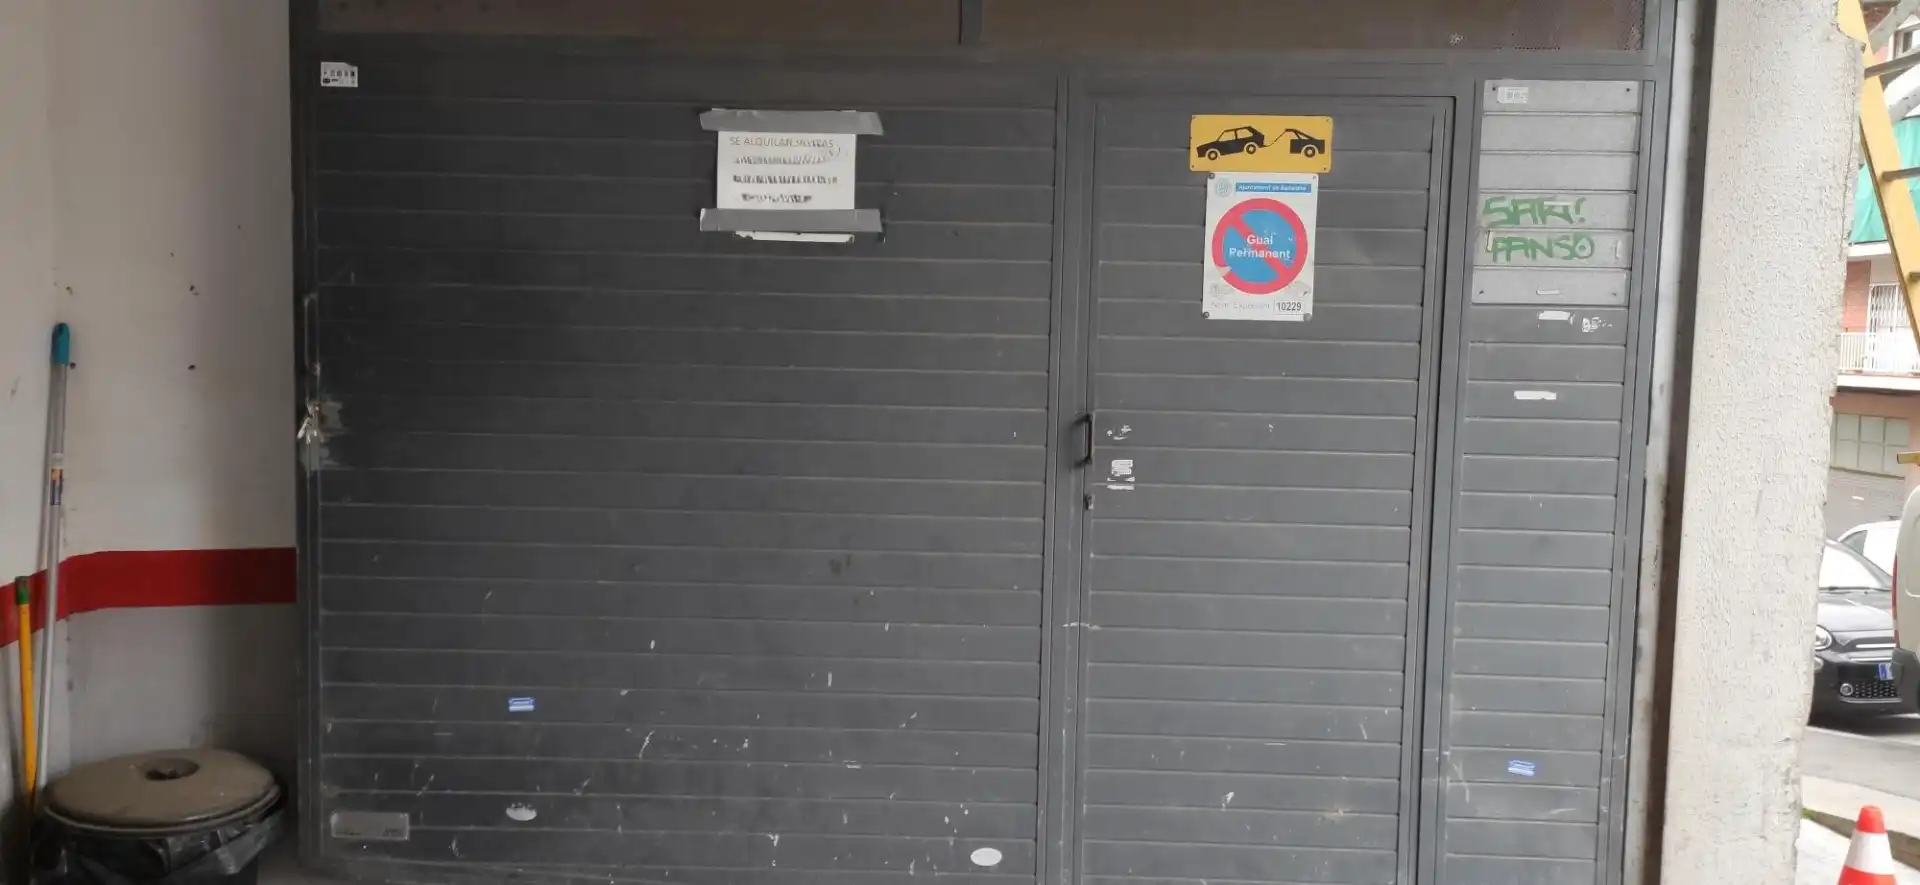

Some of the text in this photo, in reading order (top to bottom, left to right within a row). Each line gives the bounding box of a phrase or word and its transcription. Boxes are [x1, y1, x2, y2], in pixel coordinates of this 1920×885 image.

[729, 136, 741, 146] SE
[1246, 234, 1273, 245] Gual
[1229, 247, 1291, 259] Permanent
[1276, 301, 1302, 311] 10229
